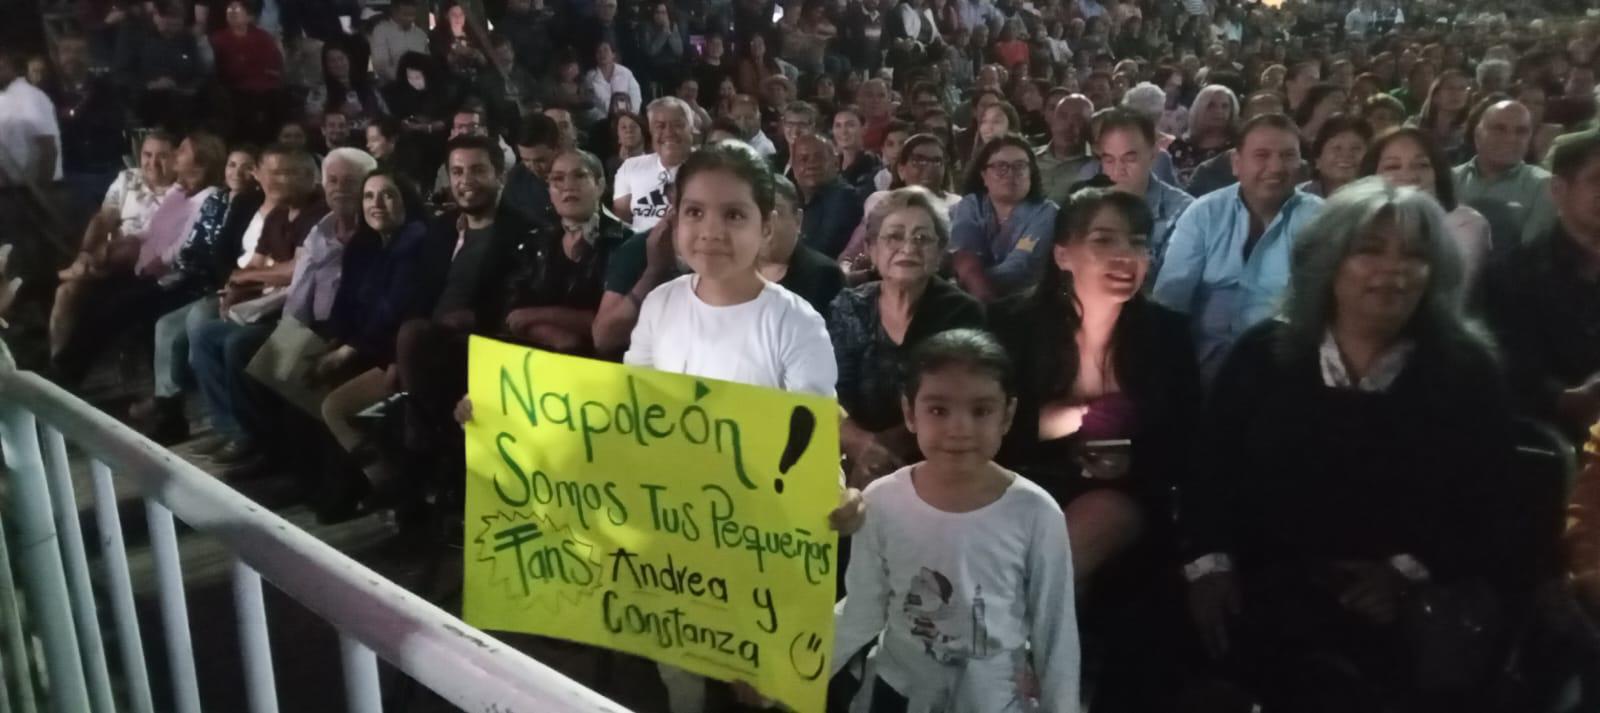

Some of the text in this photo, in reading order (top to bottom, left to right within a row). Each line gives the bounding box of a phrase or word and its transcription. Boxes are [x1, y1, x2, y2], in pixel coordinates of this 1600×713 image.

[633, 204, 671, 218] adid
[499, 351, 757, 490] Napoleón
[493, 432, 832, 585] Somos Tus Pequeños
[602, 590, 760, 668] Constanza
[609, 548, 728, 603] Andrea
[752, 586, 778, 633] y
